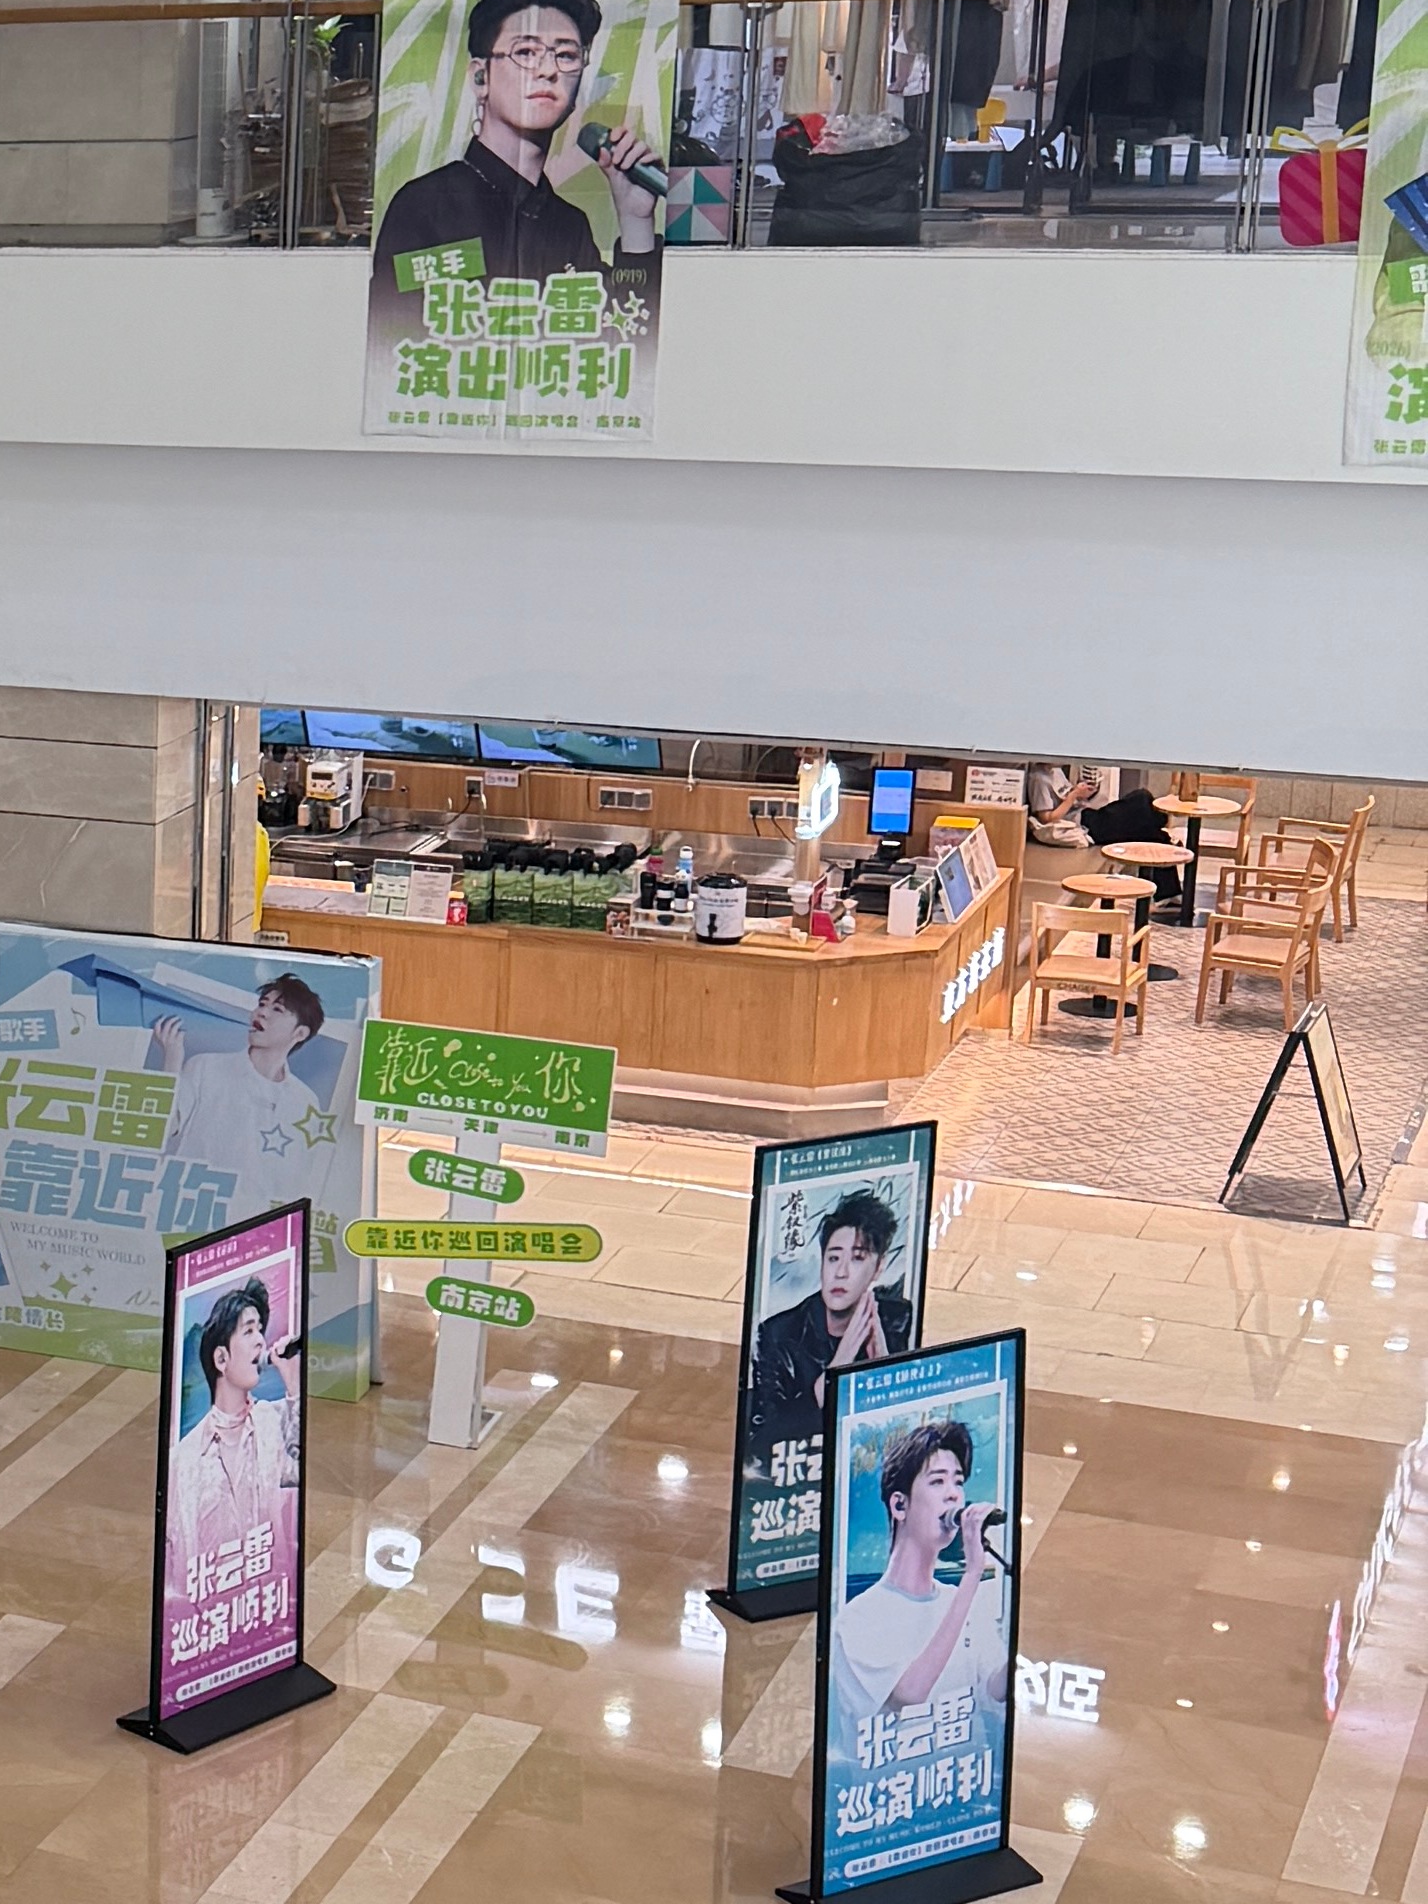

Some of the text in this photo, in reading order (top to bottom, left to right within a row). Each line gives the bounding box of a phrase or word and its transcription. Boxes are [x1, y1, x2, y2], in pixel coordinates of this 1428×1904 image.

[411, 249, 466, 283] 歌手
[611, 267, 647, 286] (0919)
[425, 275, 604, 336] 张云雷
[396, 342, 633, 401] 演出顺利
[416, 1091, 550, 1120] CLOSE TO YOU
[373, 1106, 591, 1148] 济南 天津 南京
[424, 1157, 507, 1197] 张云雷
[9, 1221, 100, 1244] WELCOME TO
[27, 1238, 48, 1254] MY
[50, 1241, 106, 1260] MUSIC
[365, 1227, 583, 1254] 靠近你巡回演唱会
[439, 1283, 522, 1322] 南京站
[770, 1438, 824, 1489] 张云
[750, 1491, 822, 1545] 巡演
[186, 1521, 275, 1605] 张云雷
[169, 1572, 290, 1668] 巡演顺利
[856, 1687, 976, 1770] 张云雷
[836, 1749, 993, 1838] 巡演顺利
